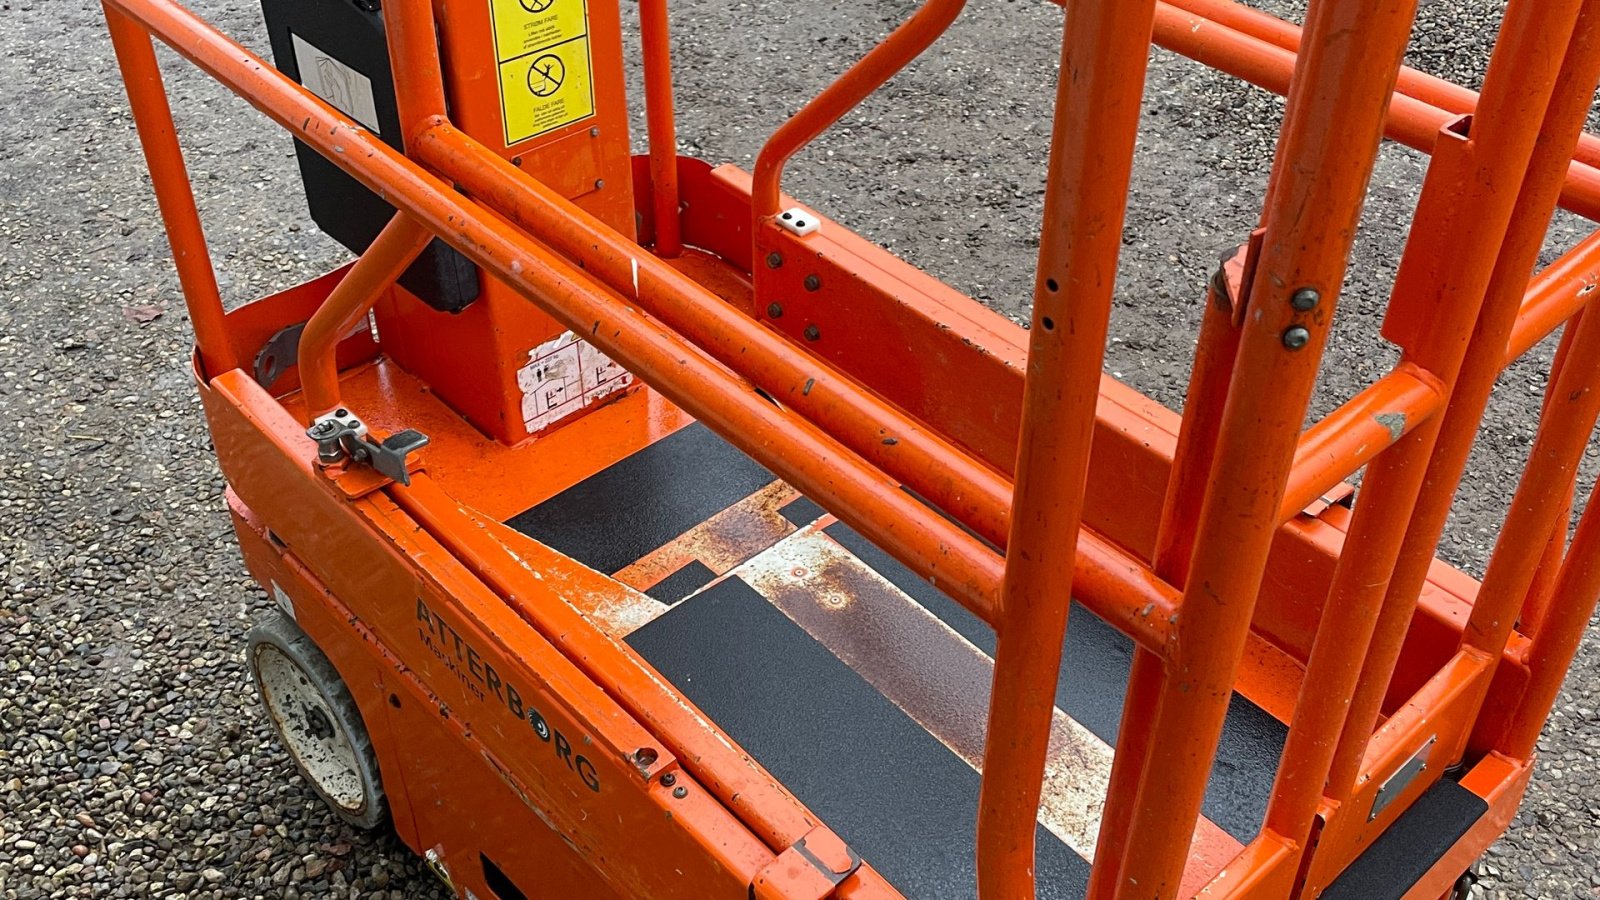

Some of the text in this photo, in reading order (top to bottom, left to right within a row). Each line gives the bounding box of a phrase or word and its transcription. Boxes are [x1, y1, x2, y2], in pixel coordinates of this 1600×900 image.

[544, 14, 558, 23] FARE
[533, 98, 564, 113] FALDE FARE
[418, 627, 485, 703] Maskiner
[416, 597, 600, 793] ATTERBORG
